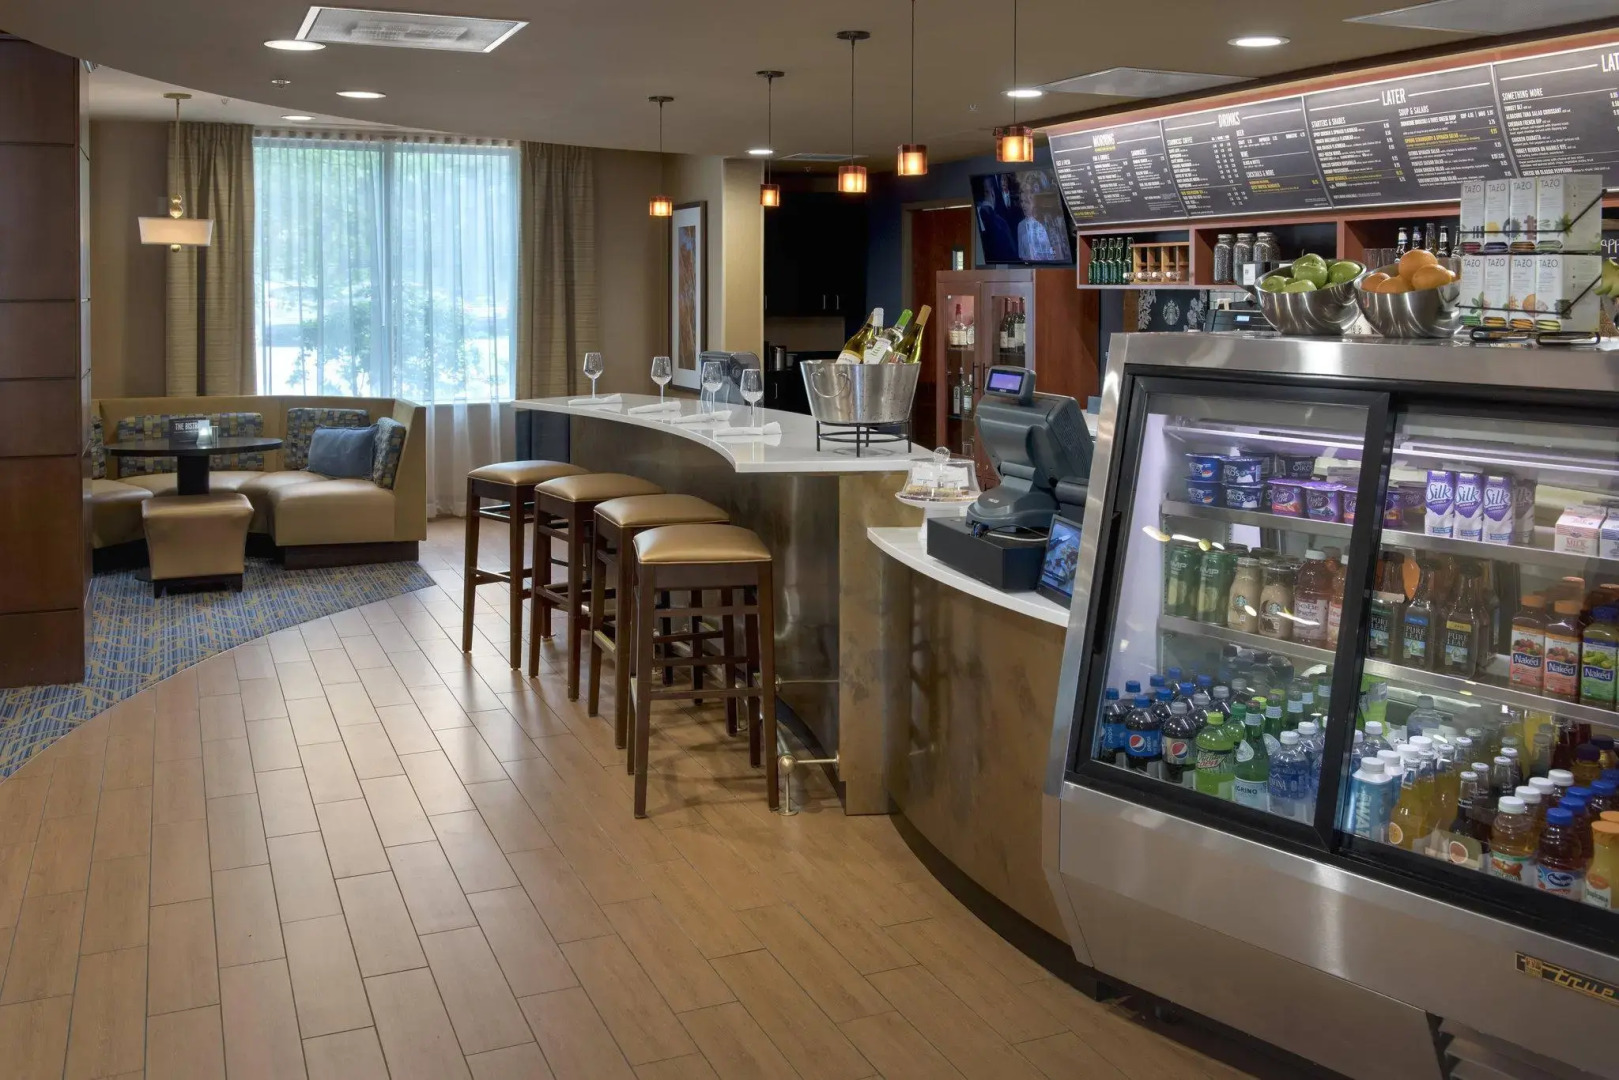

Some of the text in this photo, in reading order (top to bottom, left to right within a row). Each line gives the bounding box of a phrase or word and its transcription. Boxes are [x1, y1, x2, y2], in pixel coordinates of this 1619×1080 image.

[1381, 88, 1406, 106] LATER
[1501, 87, 1544, 101] SOMETHING MORE
[1398, 107, 1409, 117] SOUP
[1414, 105, 1429, 114] SALADS
[1218, 111, 1241, 128] DRINKS
[1464, 185, 1481, 193] TAZO
[1488, 184, 1506, 192] TAZO
[1513, 181, 1532, 190] TAZO
[1540, 179, 1560, 189] TAZO
[1463, 259, 1481, 268] TAZO
[1487, 258, 1506, 267] TAZO
[1513, 258, 1533, 268] TAZO
[1538, 259, 1559, 268] TAZO
[1276, 491, 1290, 499] Light
[1427, 483, 1452, 501] Silk
[1455, 485, 1479, 503] Silk
[1484, 488, 1510, 506] Silk
[1406, 625, 1424, 635] PURE
[1405, 631, 1423, 641] LEAF
[1448, 631, 1467, 641] PURE
[1447, 638, 1466, 647] LEAF
[1514, 653, 1540, 666] Naked
[1548, 662, 1574, 675] Naked
[1584, 668, 1611, 680] Naked
[1554, 969, 1615, 998] true
